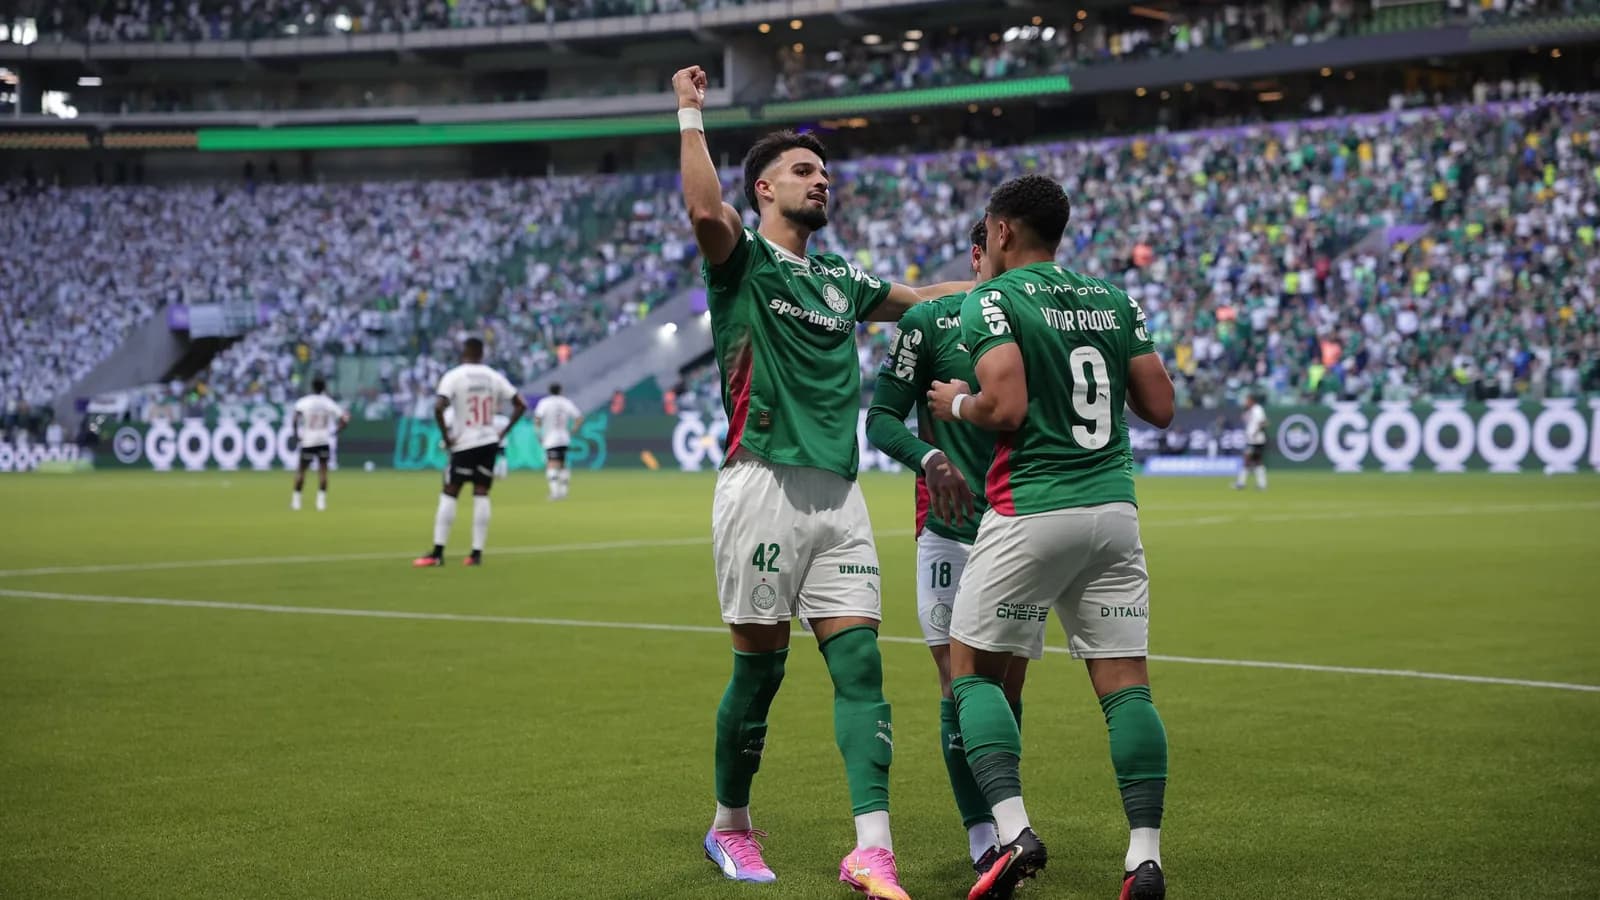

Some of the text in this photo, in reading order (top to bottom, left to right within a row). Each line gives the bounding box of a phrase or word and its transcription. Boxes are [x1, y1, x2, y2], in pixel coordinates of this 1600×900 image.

[1040, 307, 1077, 332] VITOR
[465, 395, 494, 427] 30
[1069, 345, 1112, 450] 9
[752, 542, 780, 572] 42
[930, 561, 952, 589] 18
